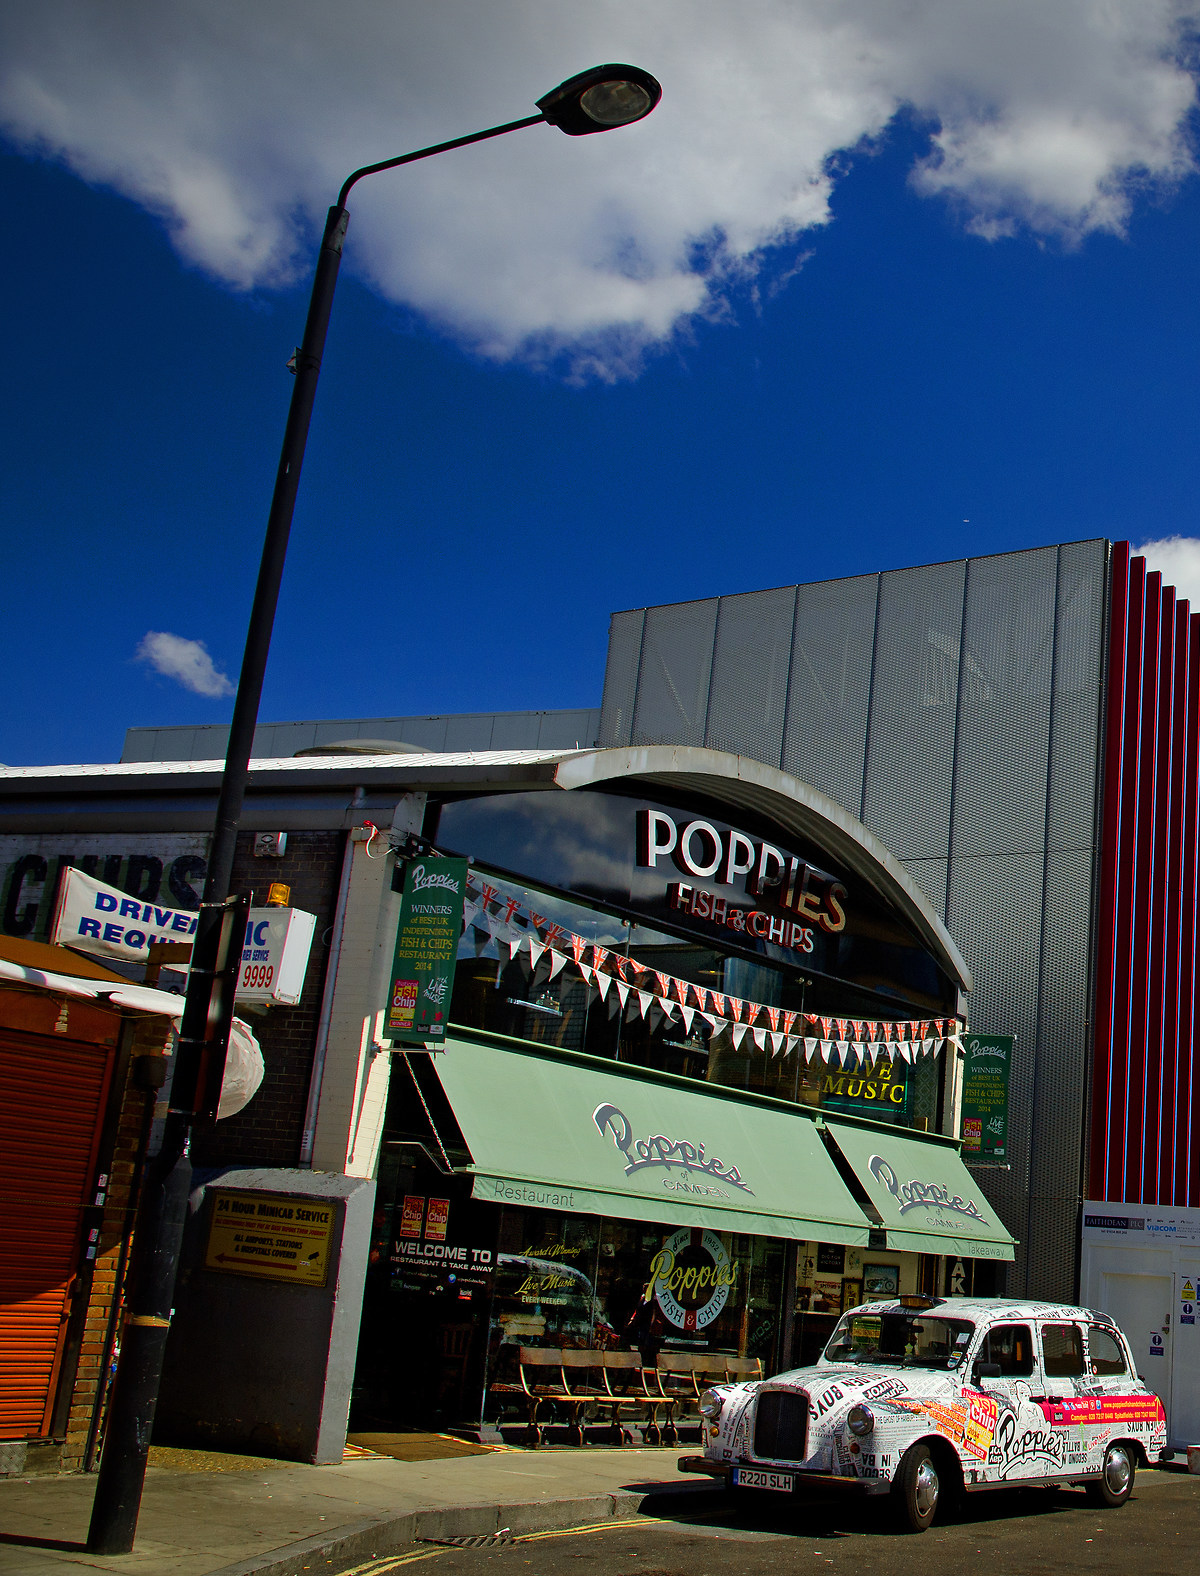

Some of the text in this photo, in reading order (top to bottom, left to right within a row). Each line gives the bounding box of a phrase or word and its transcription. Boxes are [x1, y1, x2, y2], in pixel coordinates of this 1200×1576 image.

[411, 864, 459, 894] Poppies
[636, 809, 849, 933] POPPIES
[4, 854, 207, 936] CPS
[411, 904, 453, 915] WINNERS
[667, 882, 815, 954] FISH & CHIPS
[417, 917, 434, 925] BEST
[402, 926, 454, 937] INDEPENDENT
[400, 938, 453, 950] FISH & CHIPS
[399, 949, 452, 960] RESTAURANT
[414, 961, 432, 971] 2014
[243, 965, 274, 988] 9999
[395, 985, 417, 998] Fish
[393, 995, 416, 1009] Chip
[971, 1066, 1003, 1074] WINNERS
[823, 1074, 905, 1104] MUSIC
[963, 1129, 981, 1138] Chip
[592, 1102, 757, 1198] Poppies
[680, 1170, 689, 1181] of
[494, 1180, 574, 1207] Restaurant
[661, 1178, 730, 1199] CAMDEN
[867, 1153, 991, 1228] Poppies
[217, 1199, 330, 1223] 24 HOUR MINICAB SERVICE
[403, 1209, 421, 1220] Chip
[428, 1212, 446, 1223] Chip
[275, 1239, 303, 1249] STATIONS
[518, 1243, 582, 1258] Award Winning
[672, 1232, 720, 1252] Since 1952
[966, 1242, 1004, 1258] Takeaway
[271, 1249, 298, 1259] COVERED
[395, 1240, 492, 1263] WELCOME TO
[390, 1255, 440, 1266] RESTAURANT
[449, 1262, 469, 1270] TAKE
[470, 1265, 494, 1273] AWAY
[513, 1274, 576, 1295] Live Music
[645, 1248, 739, 1303] Poppies
[951, 1256, 966, 1297] AK
[521, 1295, 568, 1306] EVERY WEEKEND
[660, 1287, 727, 1326] FISH & CHIPS
[866, 1378, 903, 1400] Mirror
[950, 1402, 968, 1416] BEST
[875, 1416, 883, 1424] THE
[883, 1415, 896, 1424] GHOST
[971, 1404, 995, 1433] Chip
[968, 1428, 980, 1439] 2014
[1087, 1427, 1112, 1451] Live Music
[965, 1441, 985, 1459] WINNER
[994, 1408, 1064, 1479] Poppies
[881, 1454, 891, 1467] IN
[740, 1470, 791, 1490] R220 SLH
